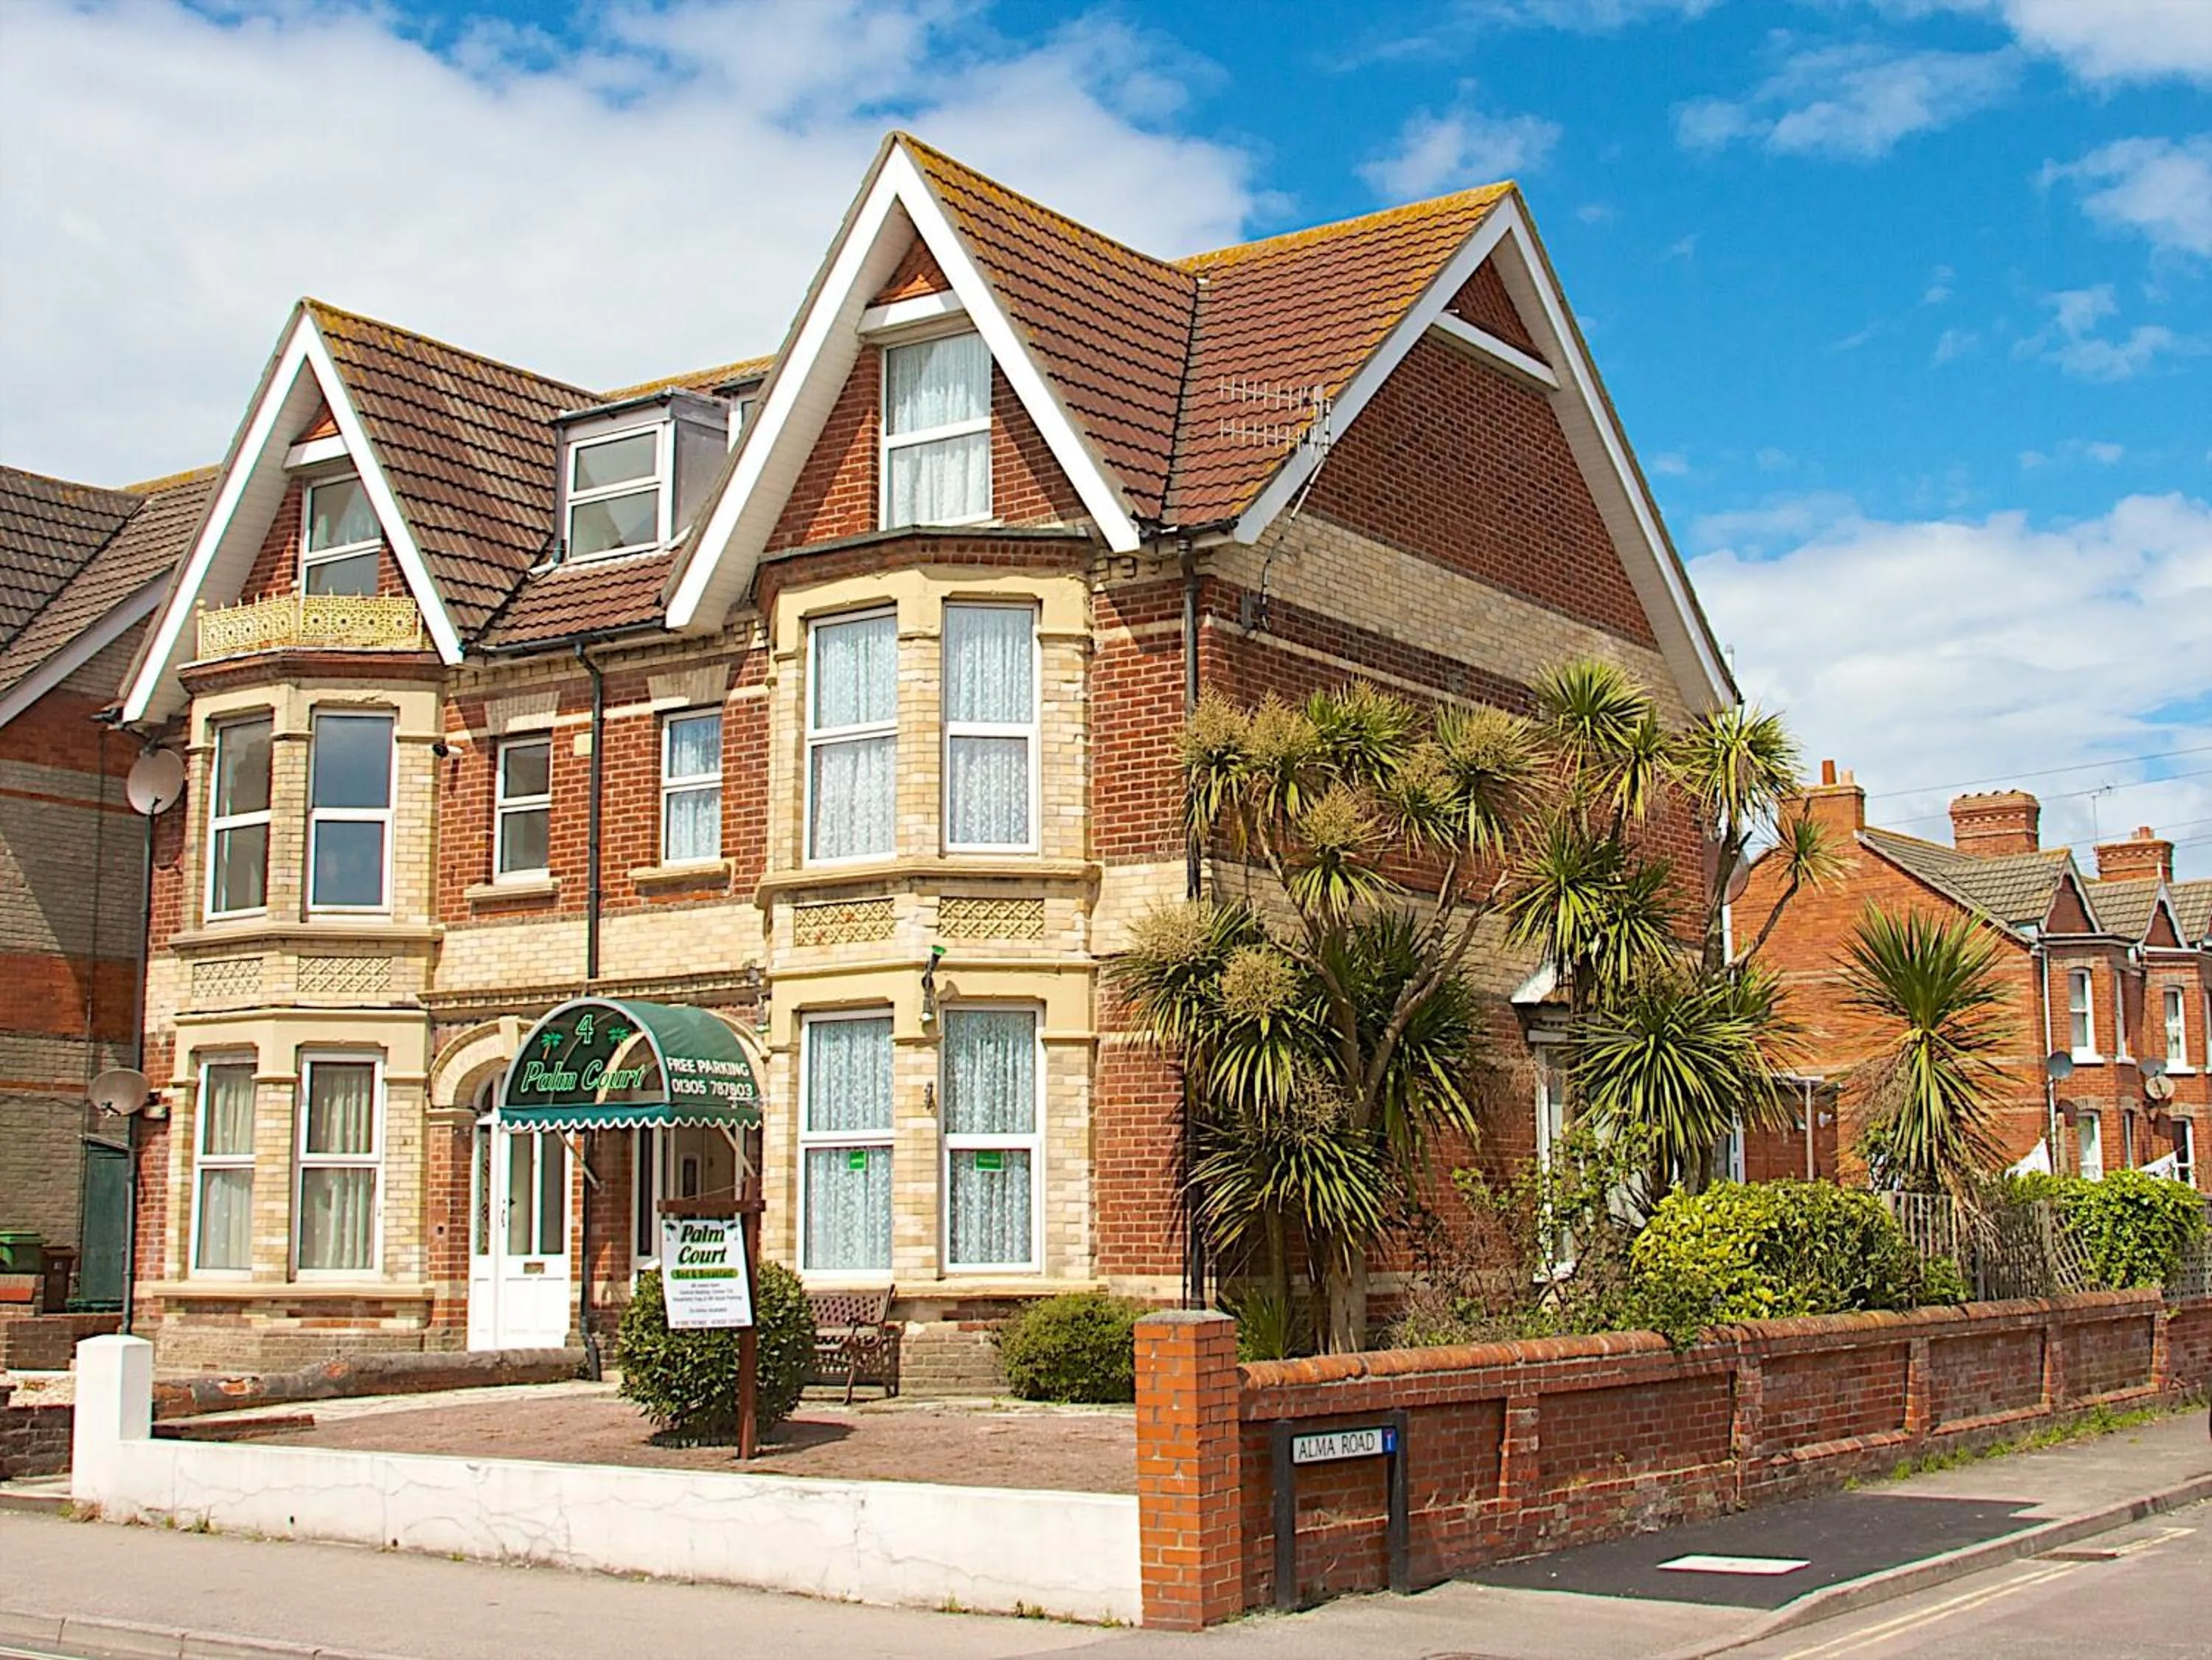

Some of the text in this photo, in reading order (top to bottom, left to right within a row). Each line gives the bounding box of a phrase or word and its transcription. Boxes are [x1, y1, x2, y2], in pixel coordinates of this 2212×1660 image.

[575, 1014, 594, 1045] 4
[520, 1059, 646, 1093] Palm Court
[666, 1056, 750, 1077] FREE PARKING
[671, 1078, 707, 1095] 01305
[680, 1224, 725, 1244] Palm
[678, 1245, 727, 1265] Court
[1298, 1432, 1376, 1459] ALMA ROAD
